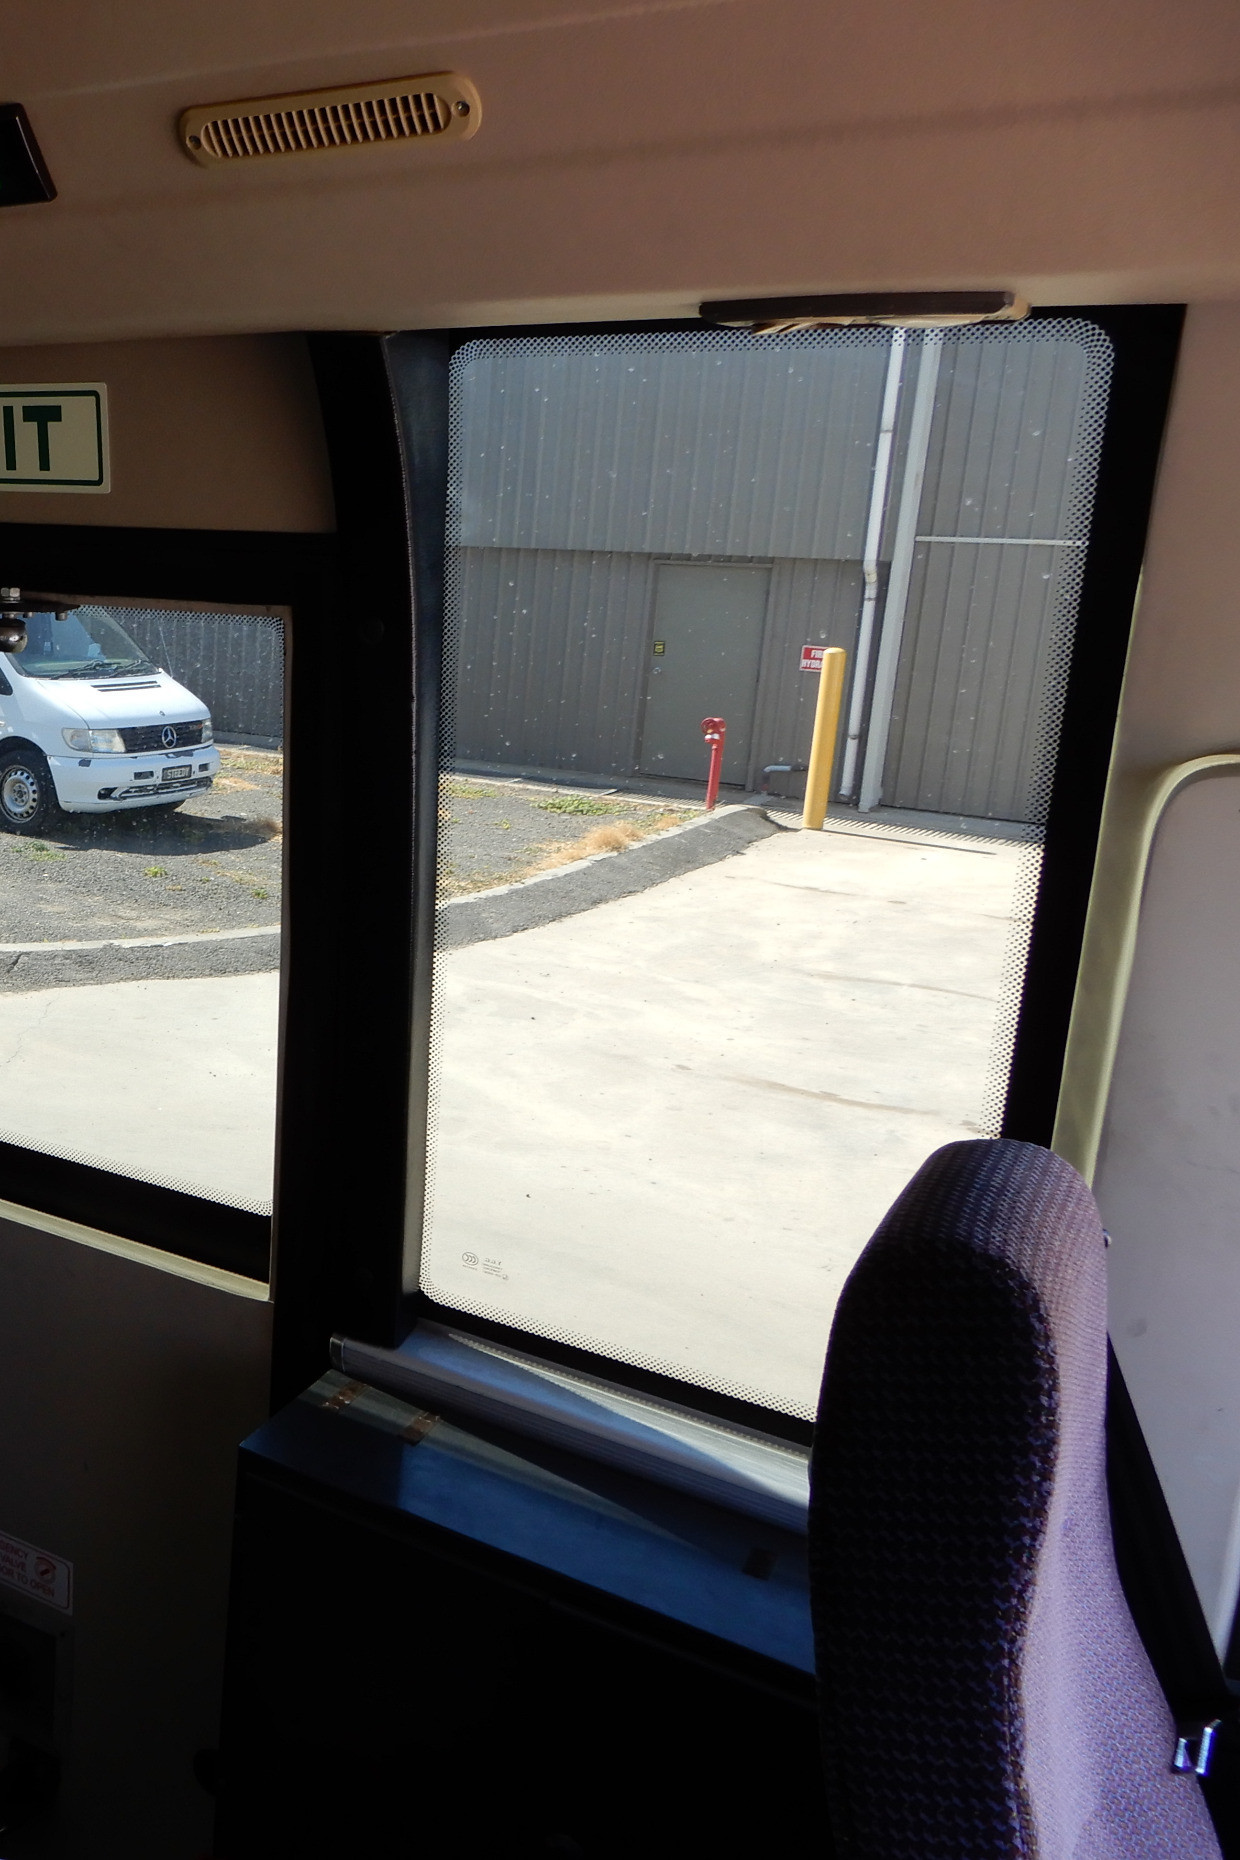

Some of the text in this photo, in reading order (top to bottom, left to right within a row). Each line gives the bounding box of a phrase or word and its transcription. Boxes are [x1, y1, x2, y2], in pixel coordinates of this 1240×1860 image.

[0, 1553, 27, 1573] VALVE
[16, 1573, 29, 1585] TO
[30, 1580, 55, 1597] OPEN
